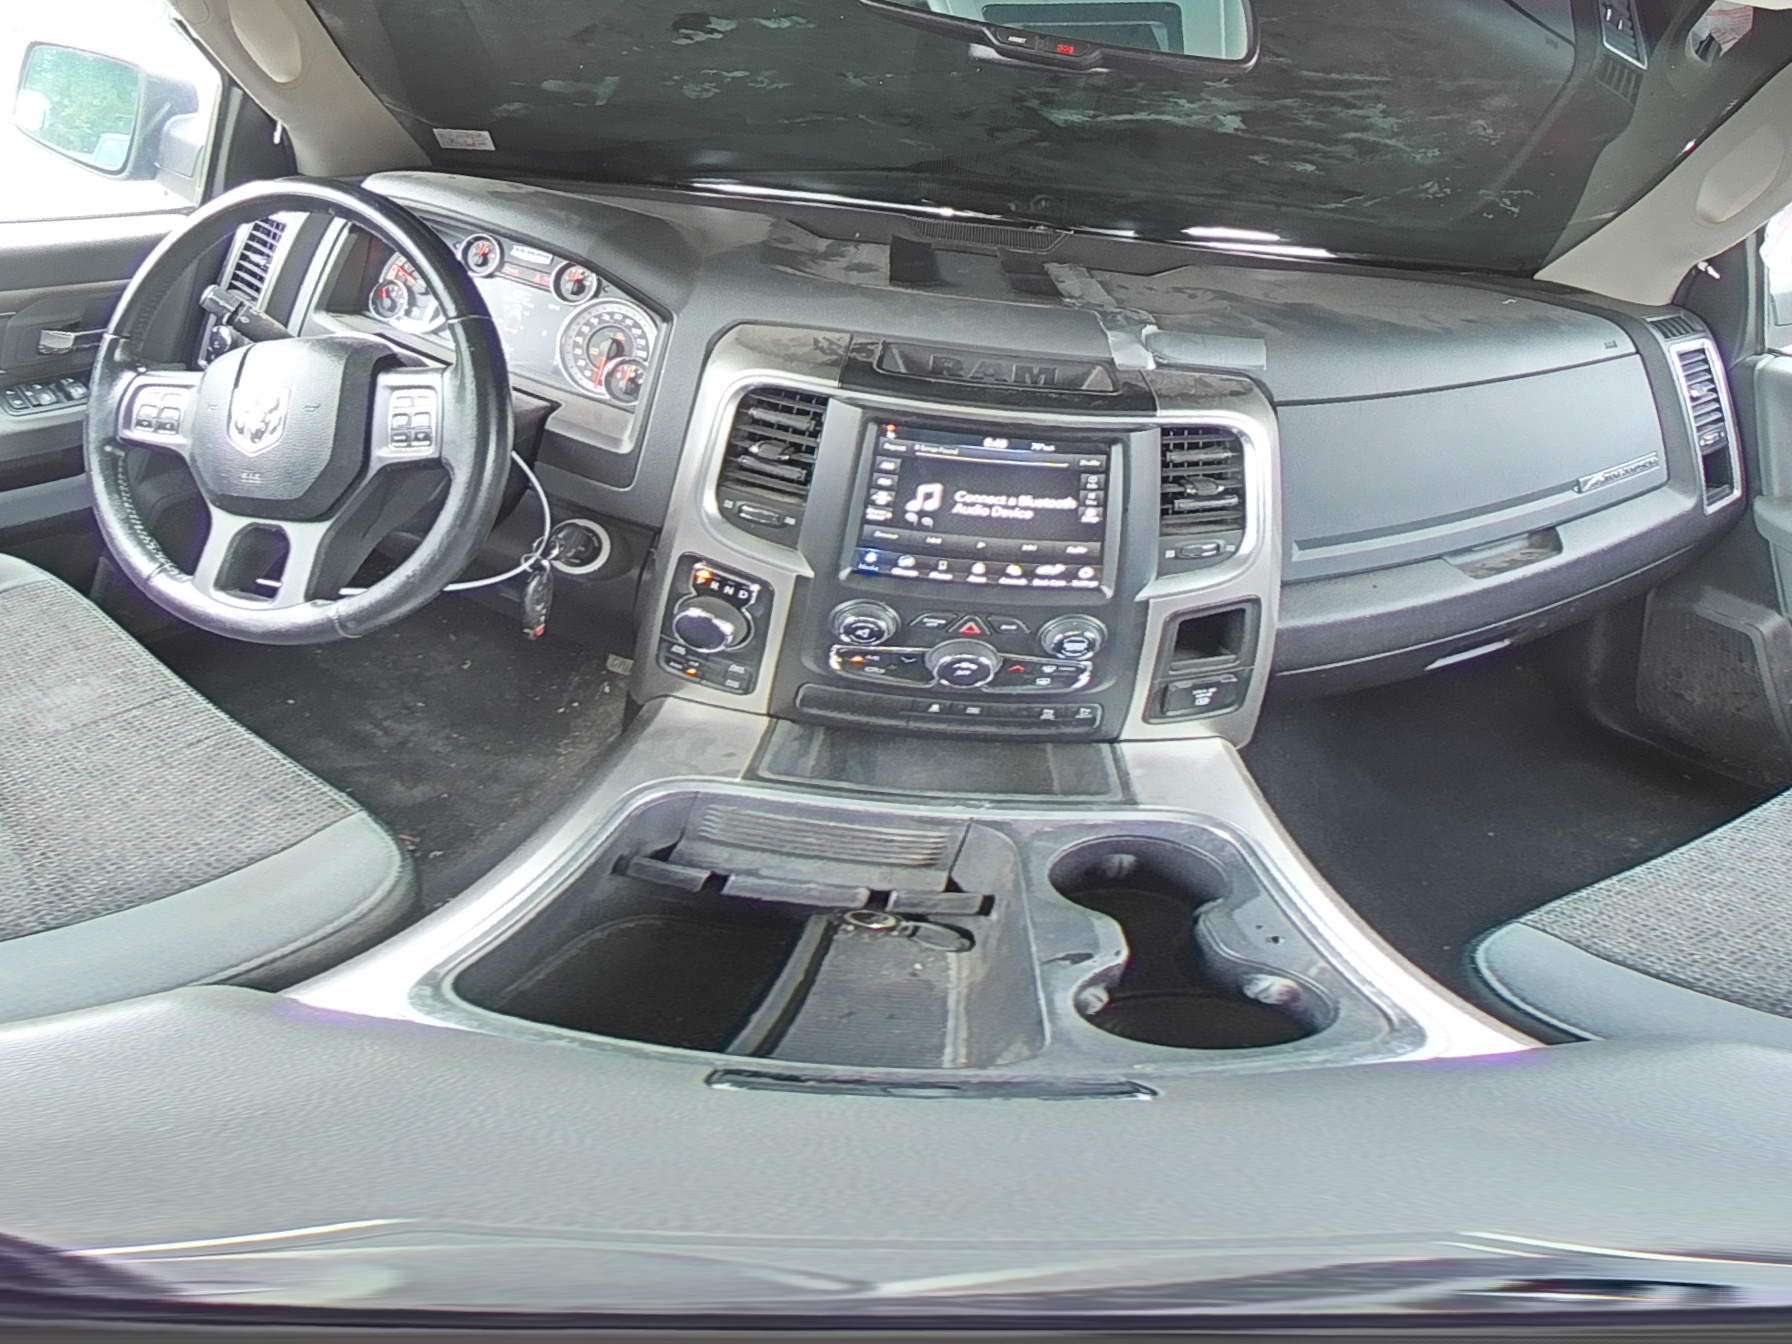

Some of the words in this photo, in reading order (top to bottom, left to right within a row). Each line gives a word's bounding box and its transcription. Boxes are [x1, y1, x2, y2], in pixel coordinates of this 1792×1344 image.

[928, 354, 1059, 386] RAM
[954, 490, 1007, 505] Connect
[1017, 495, 1078, 510] Bluetooth
[952, 502, 990, 517] Audio
[991, 505, 1034, 519] Device
[710, 580, 720, 591] R
[722, 585, 735, 596] N
[738, 589, 749, 599] D
